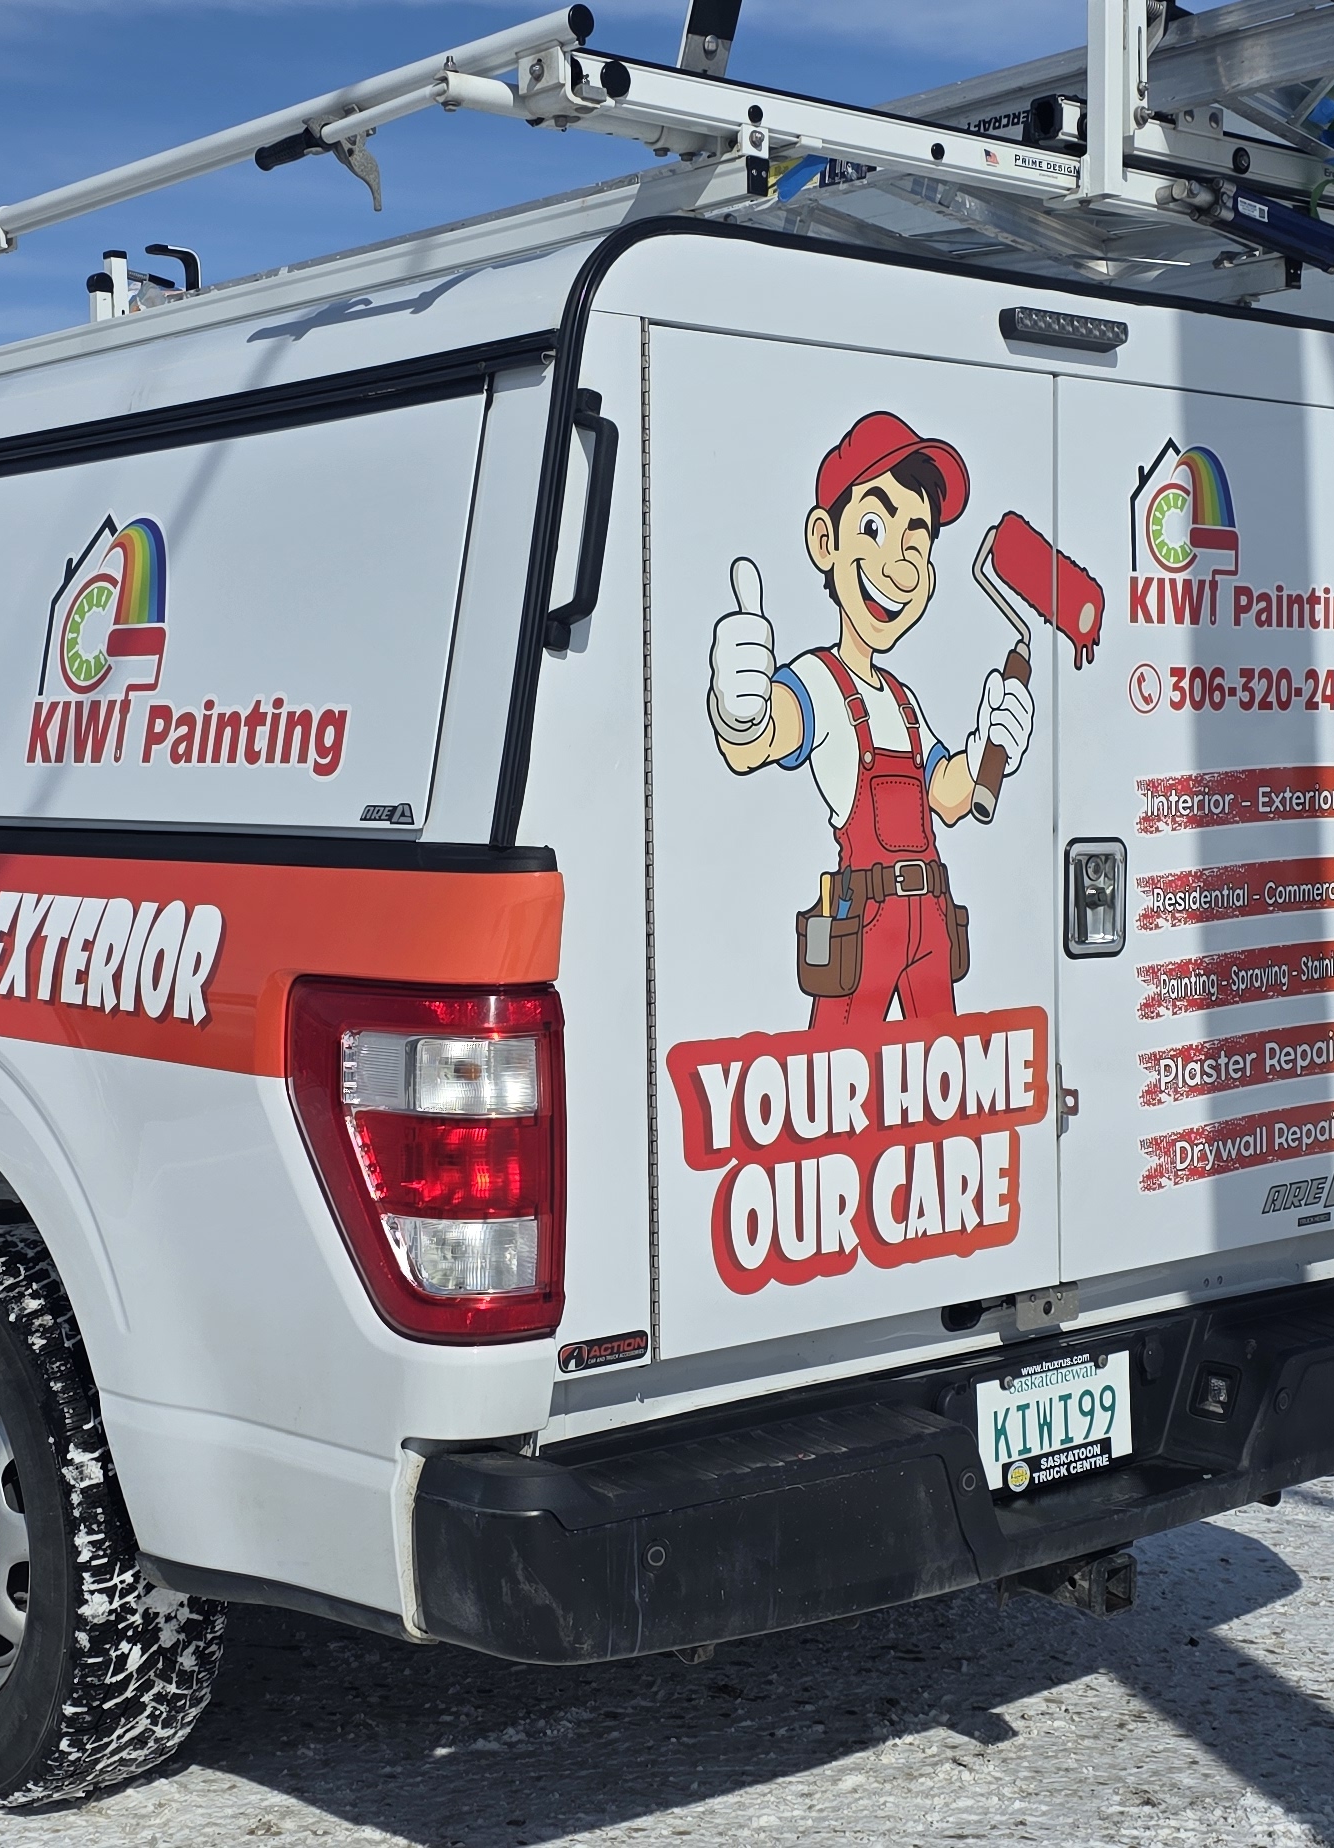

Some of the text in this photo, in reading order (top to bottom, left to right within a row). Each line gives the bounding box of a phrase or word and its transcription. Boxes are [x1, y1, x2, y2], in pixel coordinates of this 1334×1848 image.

[1014, 154, 1043, 169] PRIME
[1046, 162, 1080, 176] DESIGN
[1129, 576, 1219, 626] KIWI
[25, 697, 348, 777] KIWI Painting
[1146, 787, 1235, 816] Interior
[1152, 882, 1248, 912] Residential
[1160, 969, 1217, 1000] Painting
[1231, 960, 1289, 996] Spraying
[696, 1028, 1035, 1149] YOUR HOME
[1160, 1051, 1258, 1091] Plaster
[1175, 1127, 1267, 1171] Drywall
[730, 1131, 1011, 1270] OUR CARE
[589, 1336, 646, 1357] ACTION
[1009, 1364, 1098, 1394] Saskatchewan
[1020, 1353, 1090, 1376] www.truxrus.com
[993, 1384, 1117, 1463] KIWI99
[1032, 1464, 1069, 1484] TRUCK
[1069, 1454, 1110, 1475] CENTRE
[1040, 1444, 1101, 1470] SASKATOON
